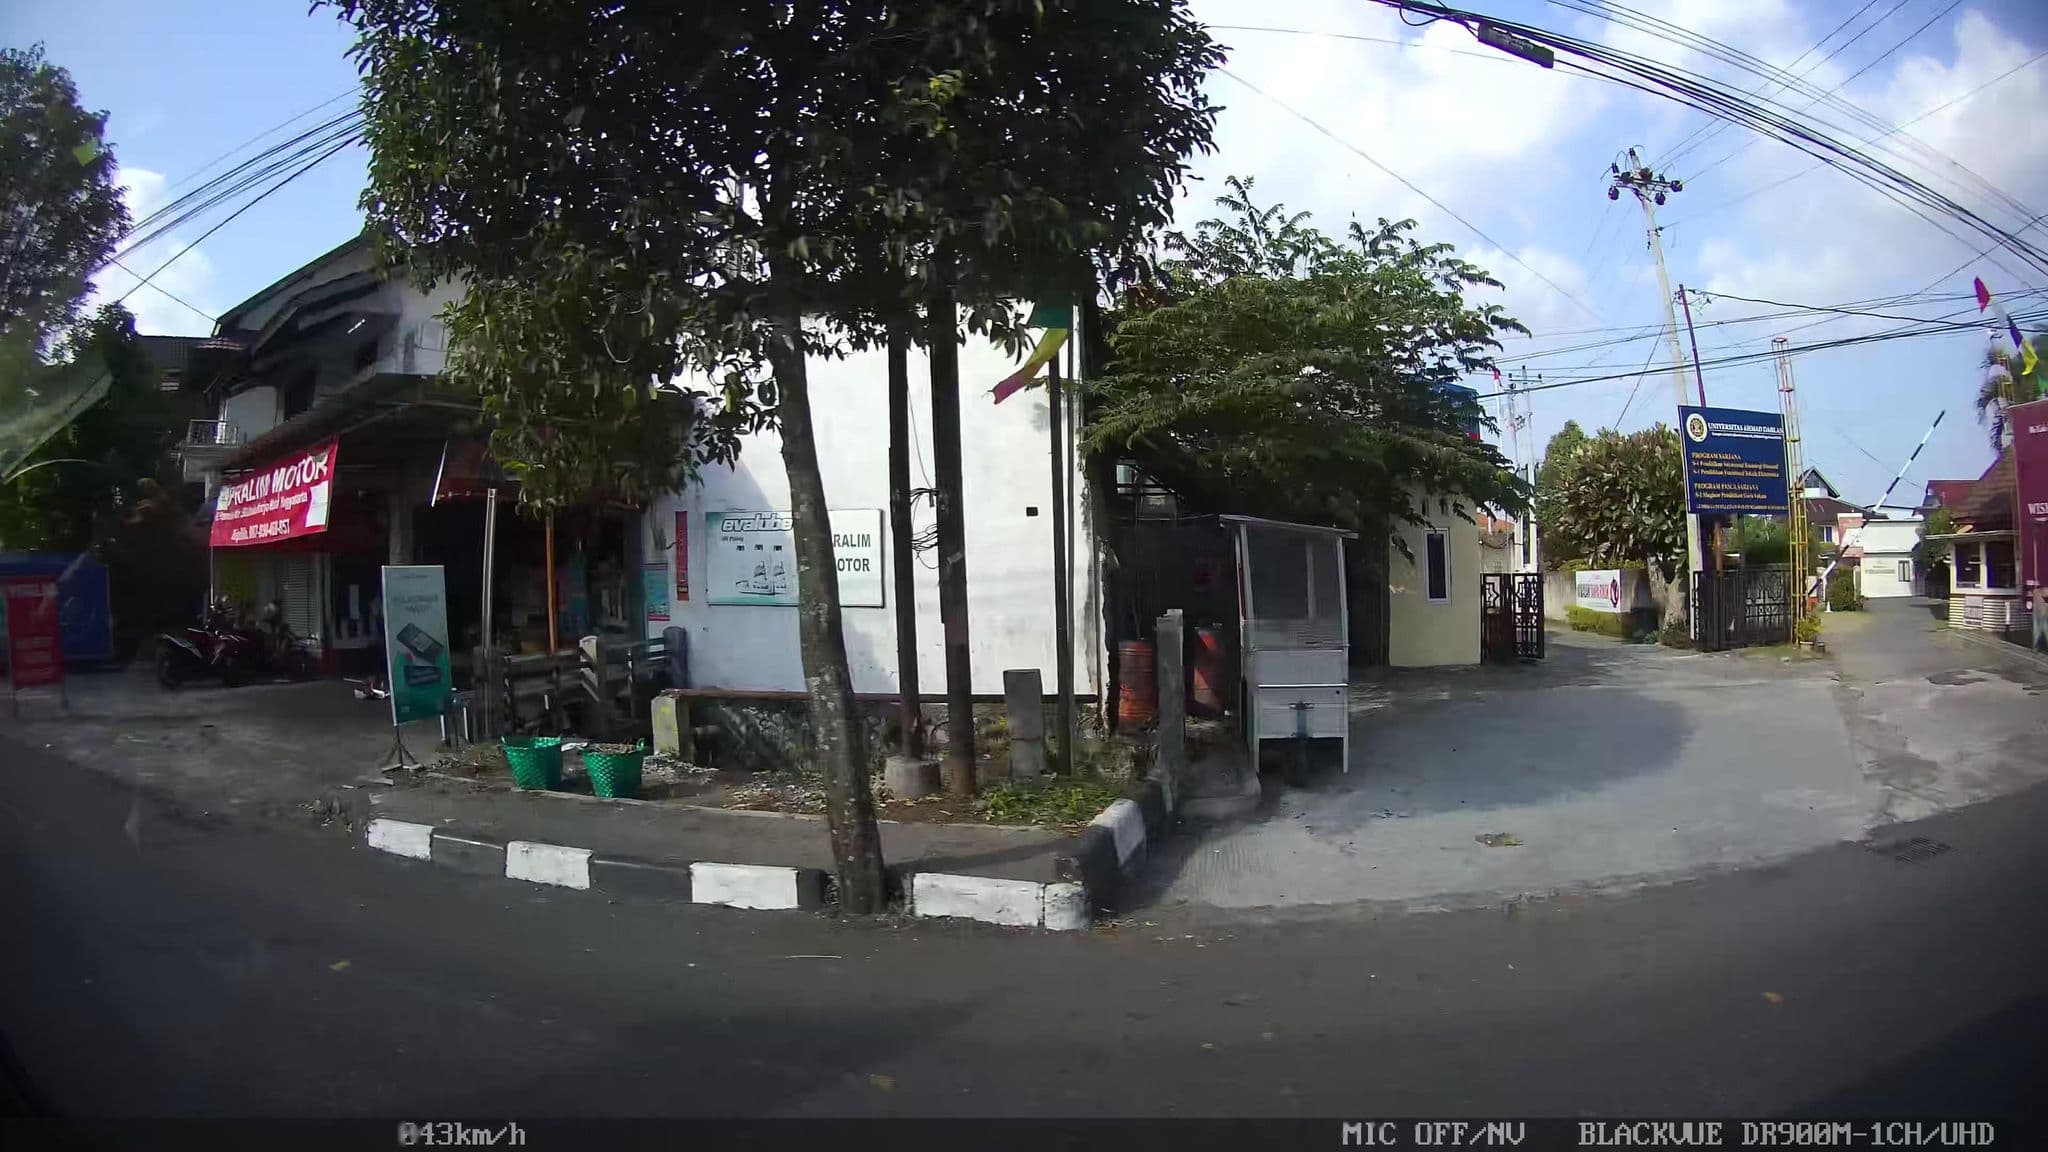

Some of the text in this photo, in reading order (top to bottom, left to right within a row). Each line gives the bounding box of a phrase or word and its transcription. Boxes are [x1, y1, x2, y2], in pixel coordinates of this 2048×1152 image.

[1708, 422, 1743, 431] UNIVERSITAS
[1743, 424, 1762, 432] AHMAD
[271, 452, 329, 494] MOTOR
[721, 512, 794, 533] evalube
[833, 533, 871, 548] RALIM
[837, 558, 870, 572] OTOR
